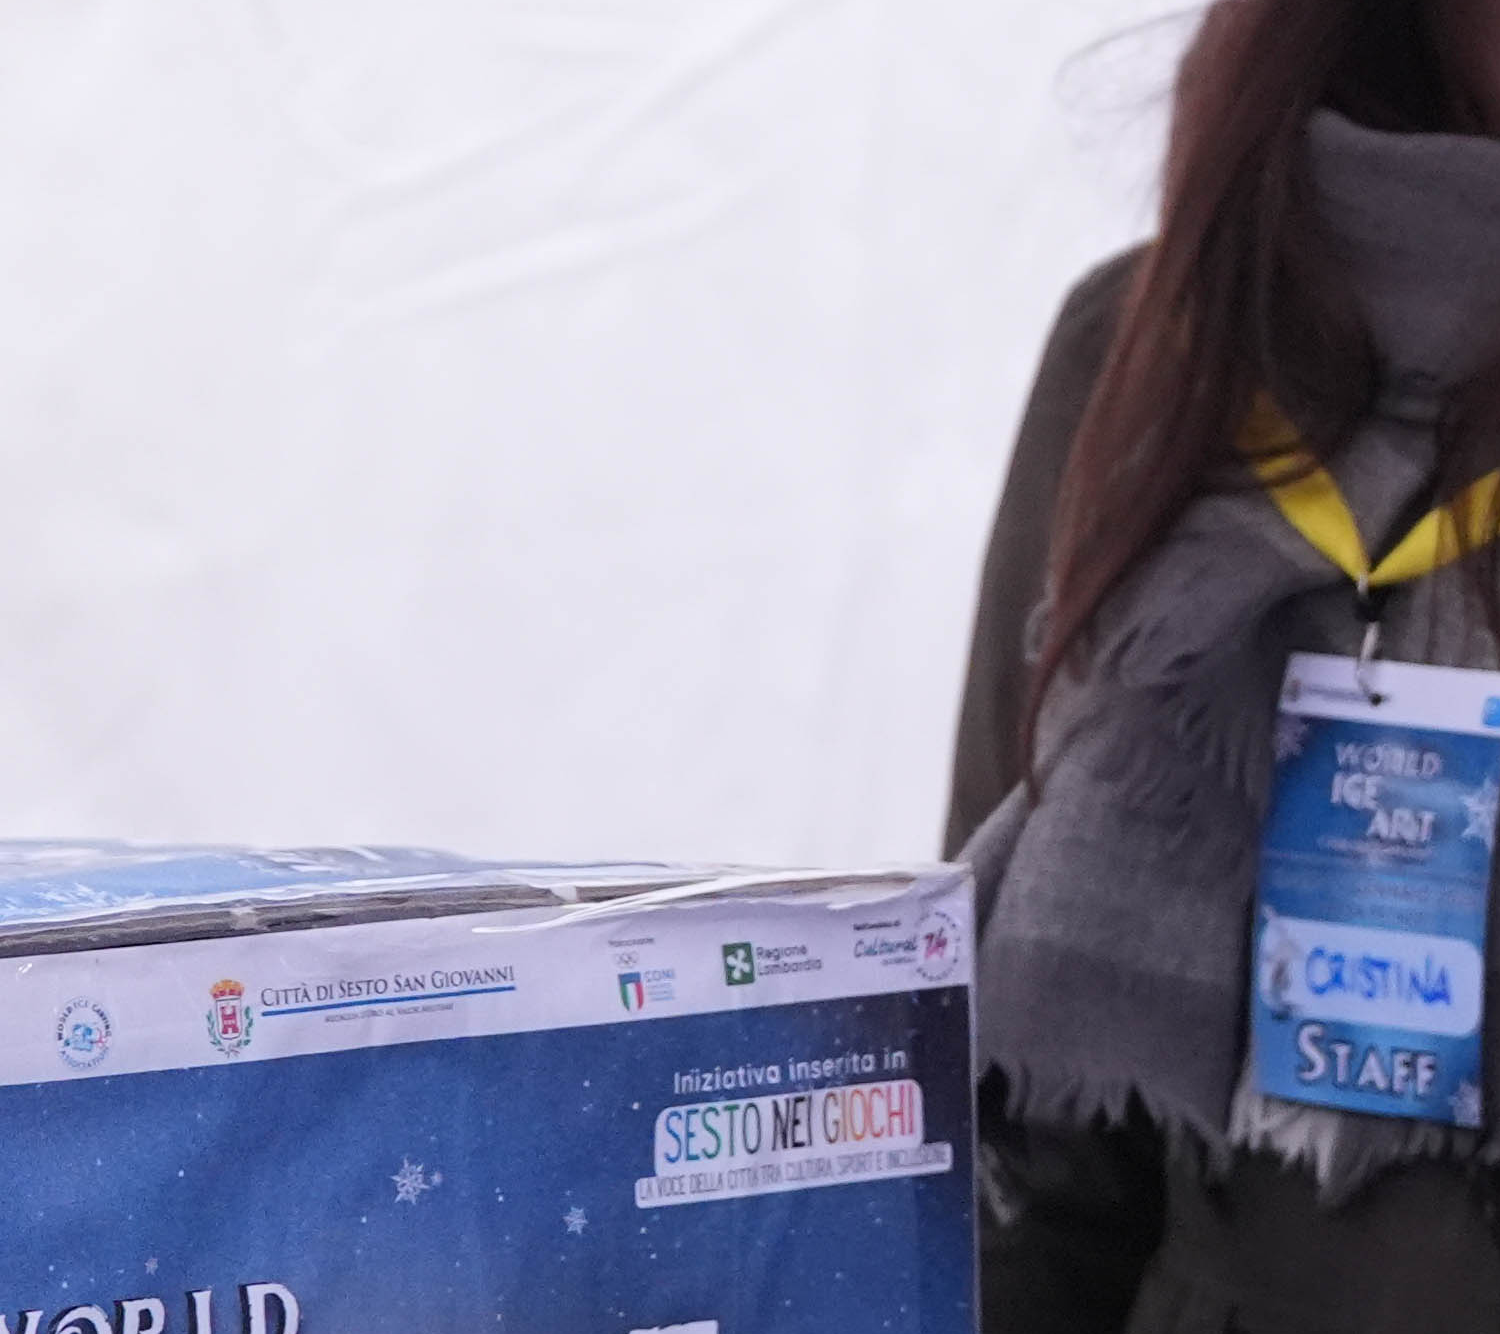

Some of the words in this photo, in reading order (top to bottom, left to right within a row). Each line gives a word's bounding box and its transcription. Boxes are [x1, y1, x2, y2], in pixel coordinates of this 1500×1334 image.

[262, 982, 311, 1007] CITTÀ
[317, 983, 334, 1000] DI
[339, 978, 388, 998] SESTO
[394, 974, 426, 993] SAN
[431, 966, 515, 988] GIOVANNI
[674, 1063, 781, 1094] Iniziativa
[788, 1053, 875, 1082] inserita
[884, 1047, 907, 1070] in
[1298, 1023, 1437, 1096] STAFF
[664, 1102, 762, 1164] SESTO
[771, 1089, 813, 1152] NEI
[822, 1083, 915, 1145] GIOCHI
